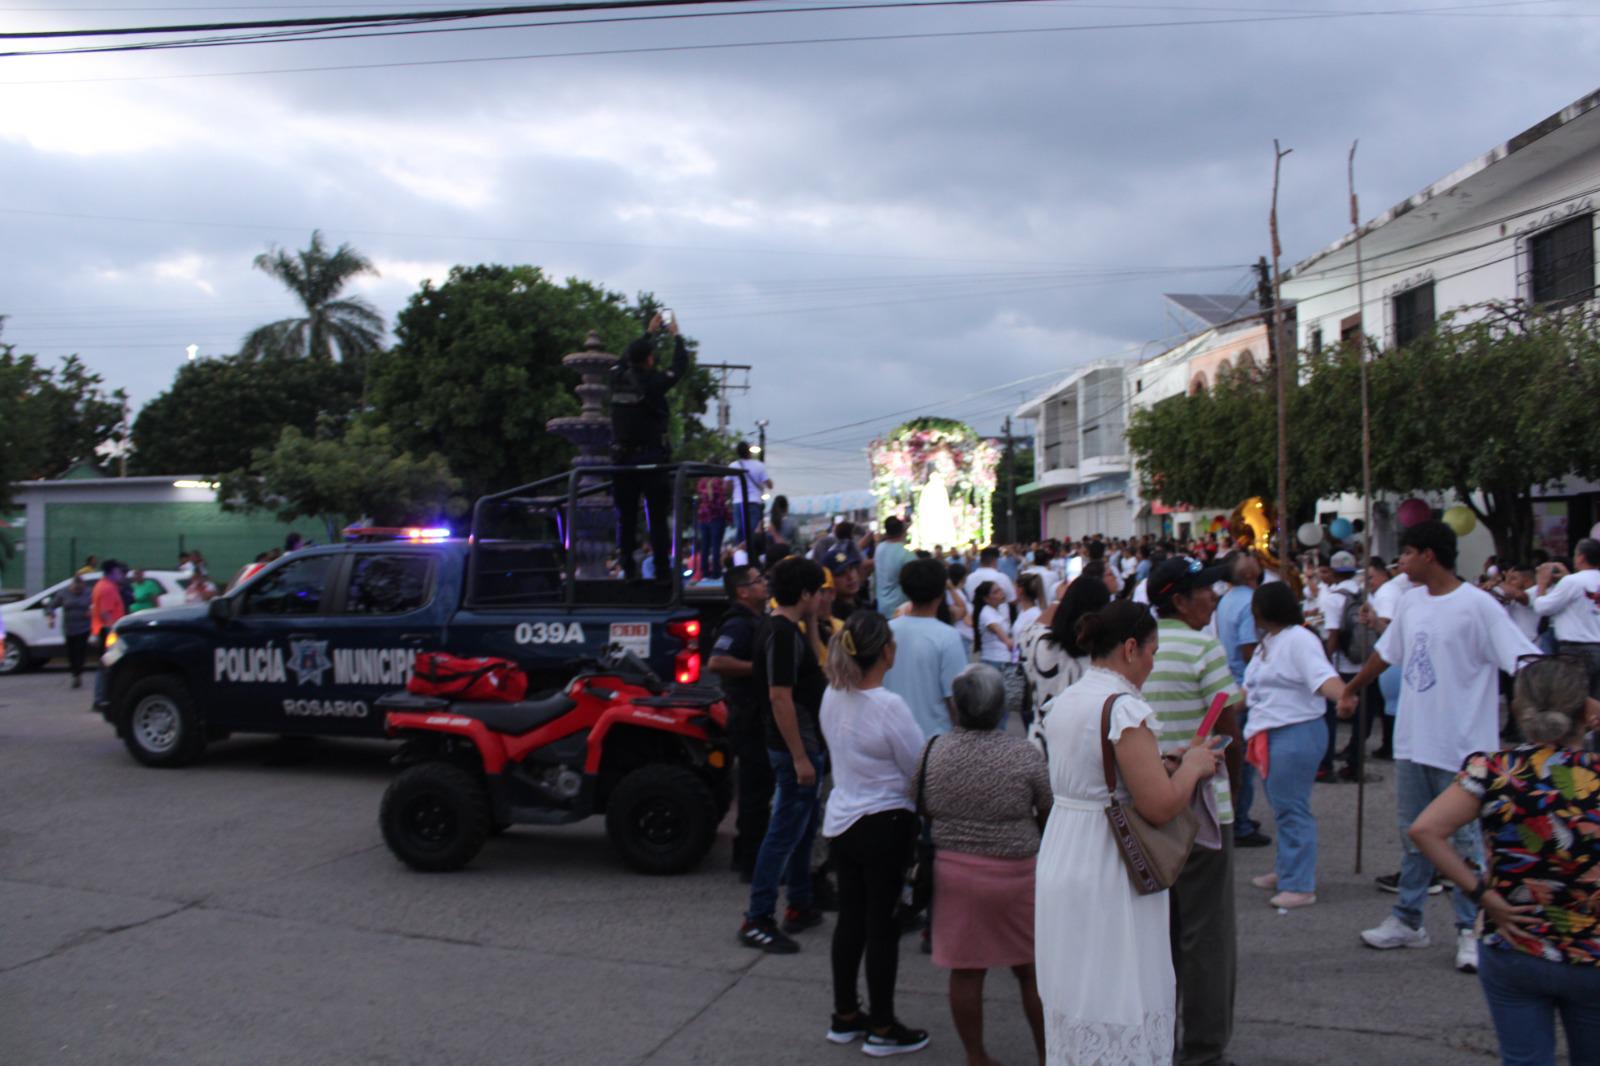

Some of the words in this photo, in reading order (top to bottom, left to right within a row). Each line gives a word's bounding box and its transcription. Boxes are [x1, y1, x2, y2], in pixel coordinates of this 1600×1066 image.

[514, 621, 586, 645] 039A
[213, 640, 287, 683] POLICÍA
[333, 647, 424, 685] MUNICIPA
[282, 698, 369, 719] ROSARIO
